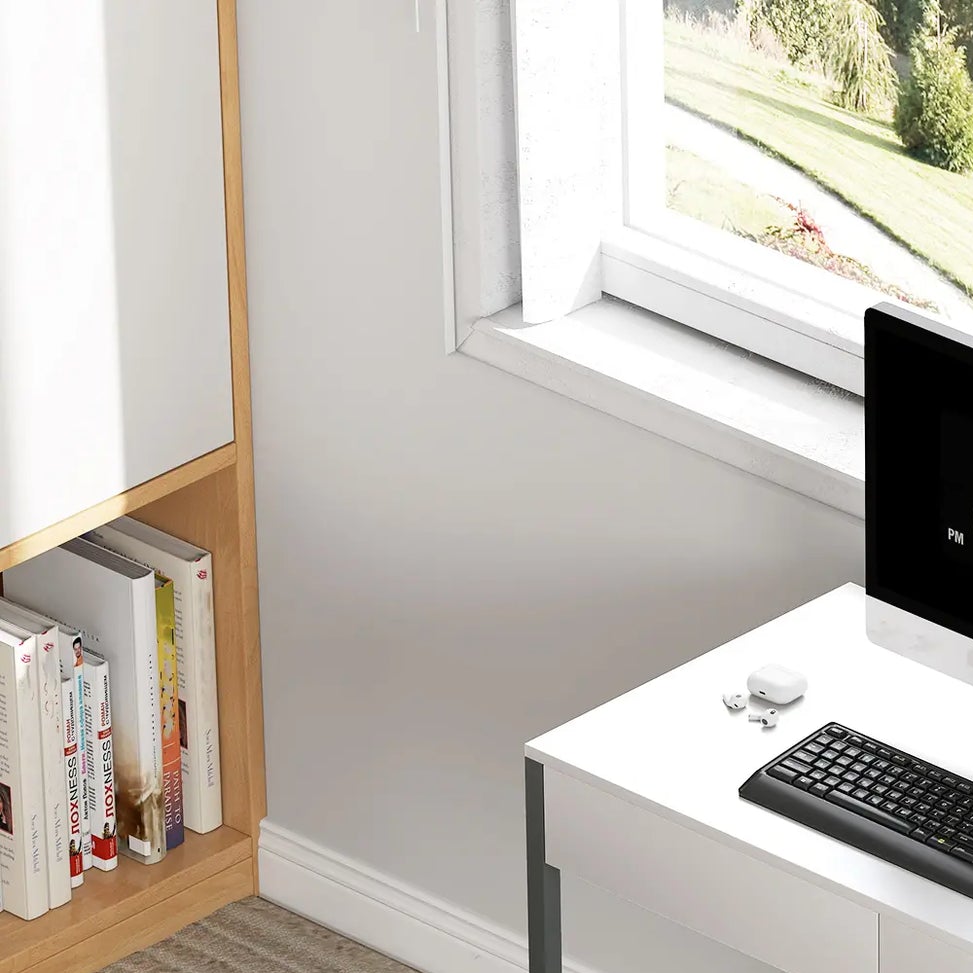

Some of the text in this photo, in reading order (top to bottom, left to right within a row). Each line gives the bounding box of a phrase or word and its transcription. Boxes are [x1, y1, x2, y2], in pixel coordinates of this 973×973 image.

[948, 527, 964, 546] PM
[163, 771, 173, 831] PARADISE
[172, 770, 182, 824] PATH TO
